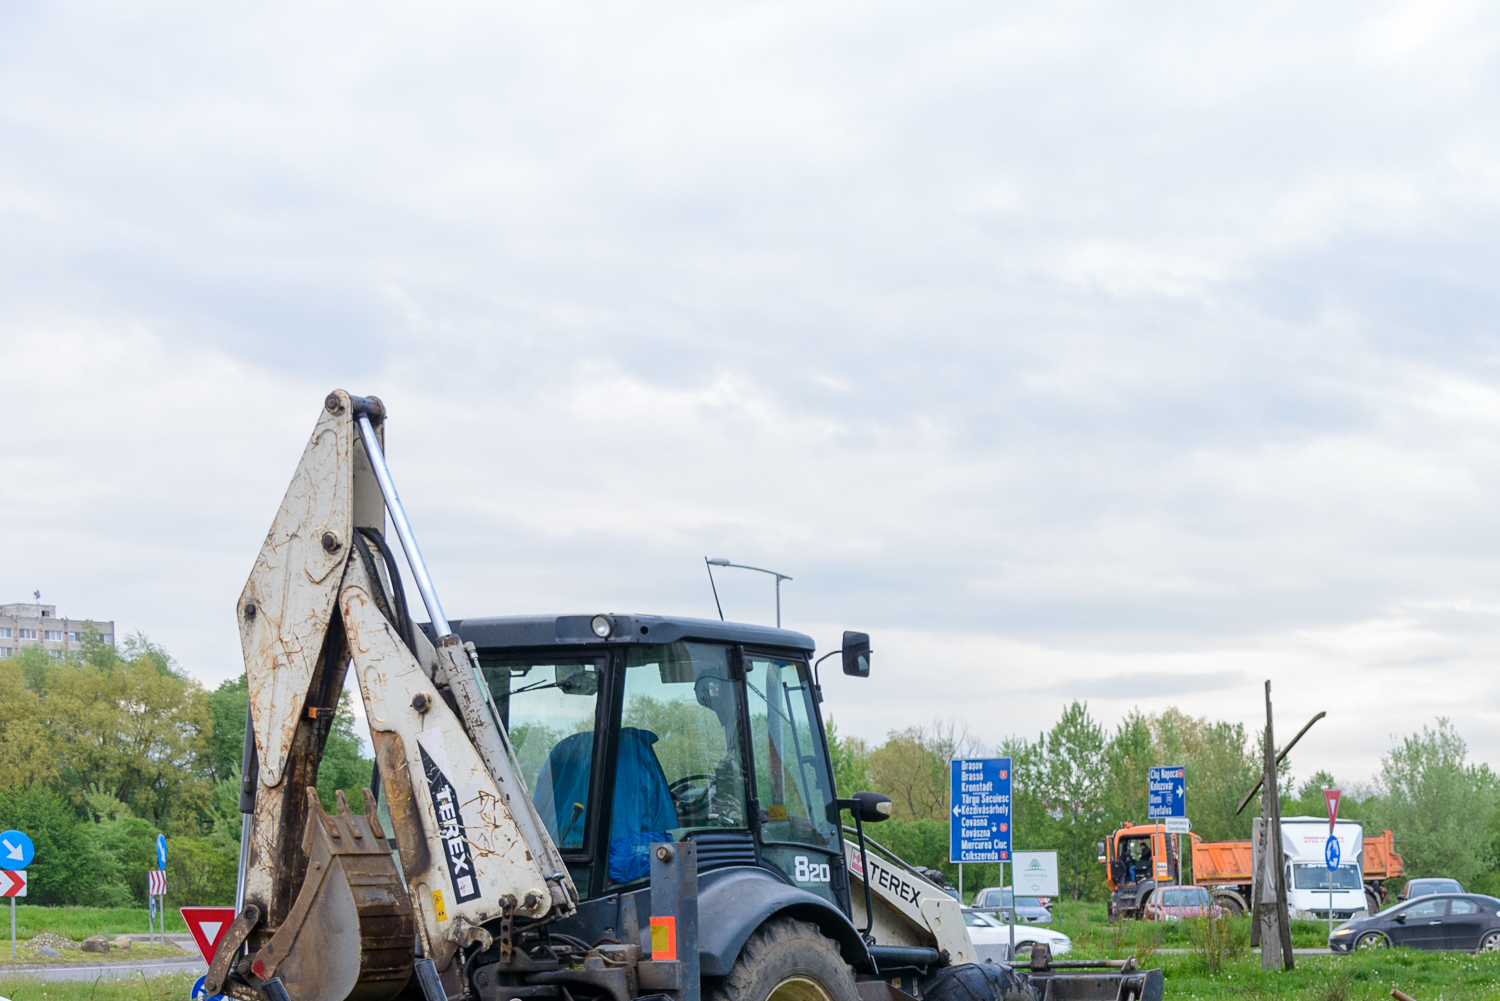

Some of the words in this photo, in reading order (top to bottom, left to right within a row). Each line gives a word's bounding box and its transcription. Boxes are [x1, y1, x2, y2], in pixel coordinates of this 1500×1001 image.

[961, 760, 983, 771] Brașov
[961, 770, 984, 781] Brassó
[1150, 769, 1160, 781] Cluj
[1161, 769, 1178, 781] Napoca
[961, 781, 993, 792] Kronstadt
[1150, 780, 1174, 791] Kolozsvár
[961, 794, 980, 806] Târgu
[981, 793, 1009, 804] Secuiesc
[961, 804, 1009, 816] Kézdivásárhely
[961, 817, 988, 827] Covasna
[435, 784, 470, 875] TEREX
[961, 827, 991, 838] Kovászna
[961, 839, 992, 850] Miercurea
[993, 839, 1007, 849] Ciuc
[961, 850, 998, 861] Csíkszereda
[794, 855, 831, 882] 820
[869, 861, 921, 909] TEREX
